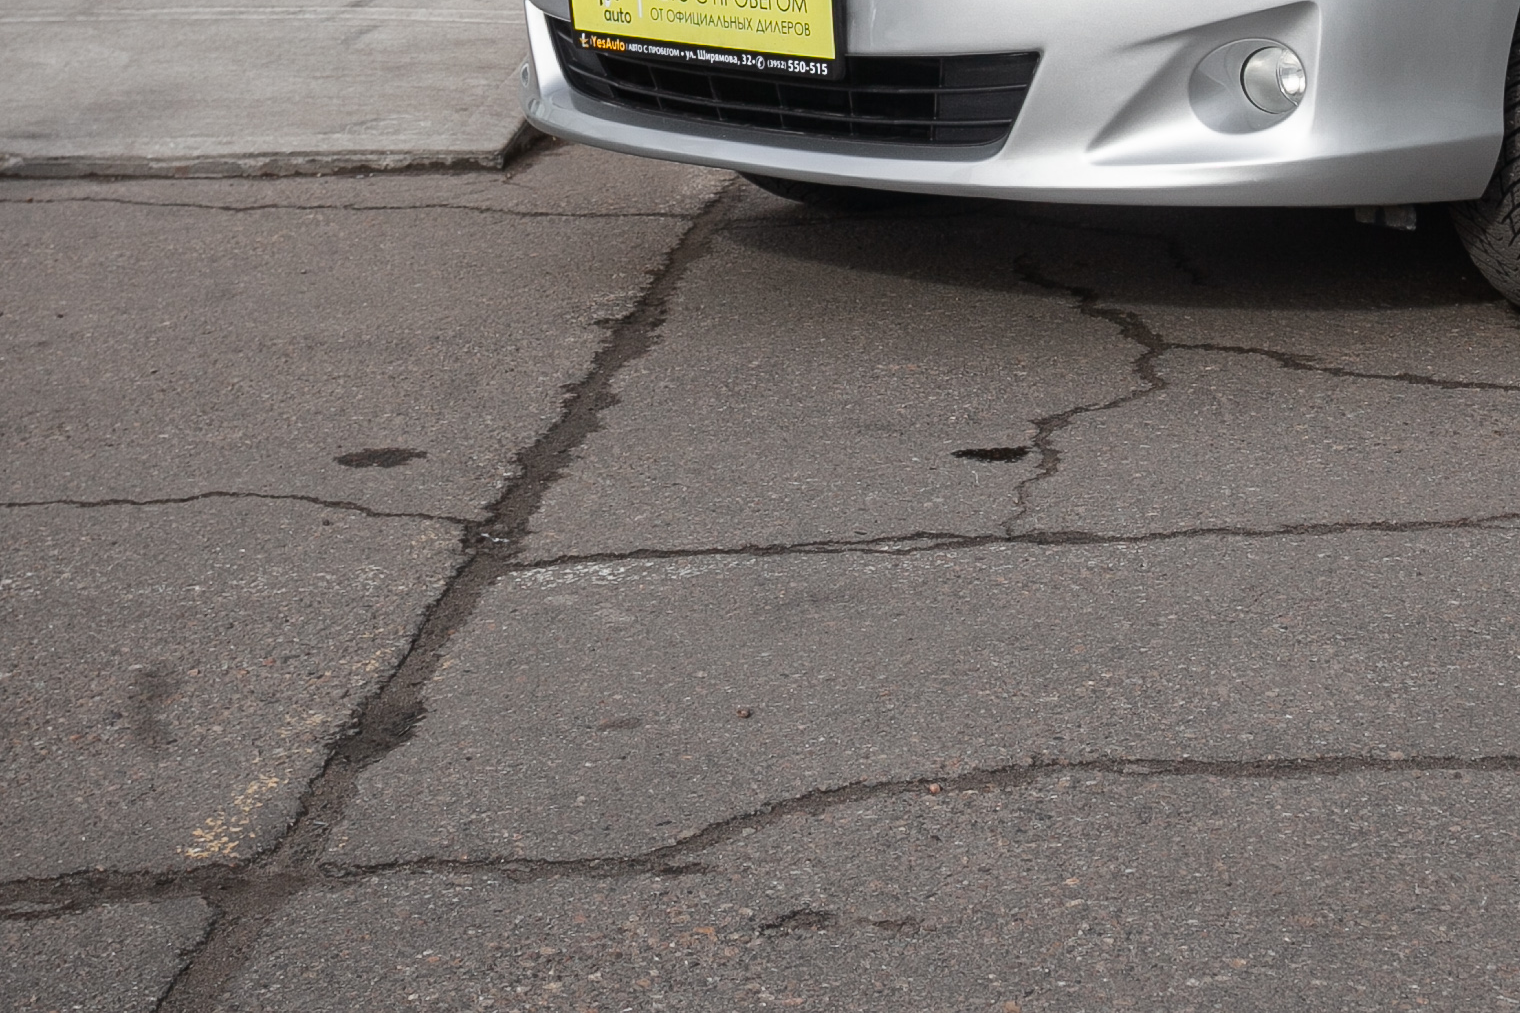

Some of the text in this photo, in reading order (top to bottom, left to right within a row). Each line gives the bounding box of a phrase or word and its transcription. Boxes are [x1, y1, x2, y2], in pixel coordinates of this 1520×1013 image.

[603, 7, 632, 24] auto
[650, 7, 811, 37] ОТ ОФИЦИАЛЬНЫХ ДИЛЕРОВ
[591, 35, 626, 52] YesAuto
[628, 42, 643, 53] АВТО
[648, 45, 680, 57] ПРОБЕГОМ
[684, 50, 697, 61] ул.
[697, 49, 741, 65] Ширямова,
[741, 54, 753, 66] 32
[767, 60, 787, 70] (3952)
[787, 60, 828, 75] 550-515
